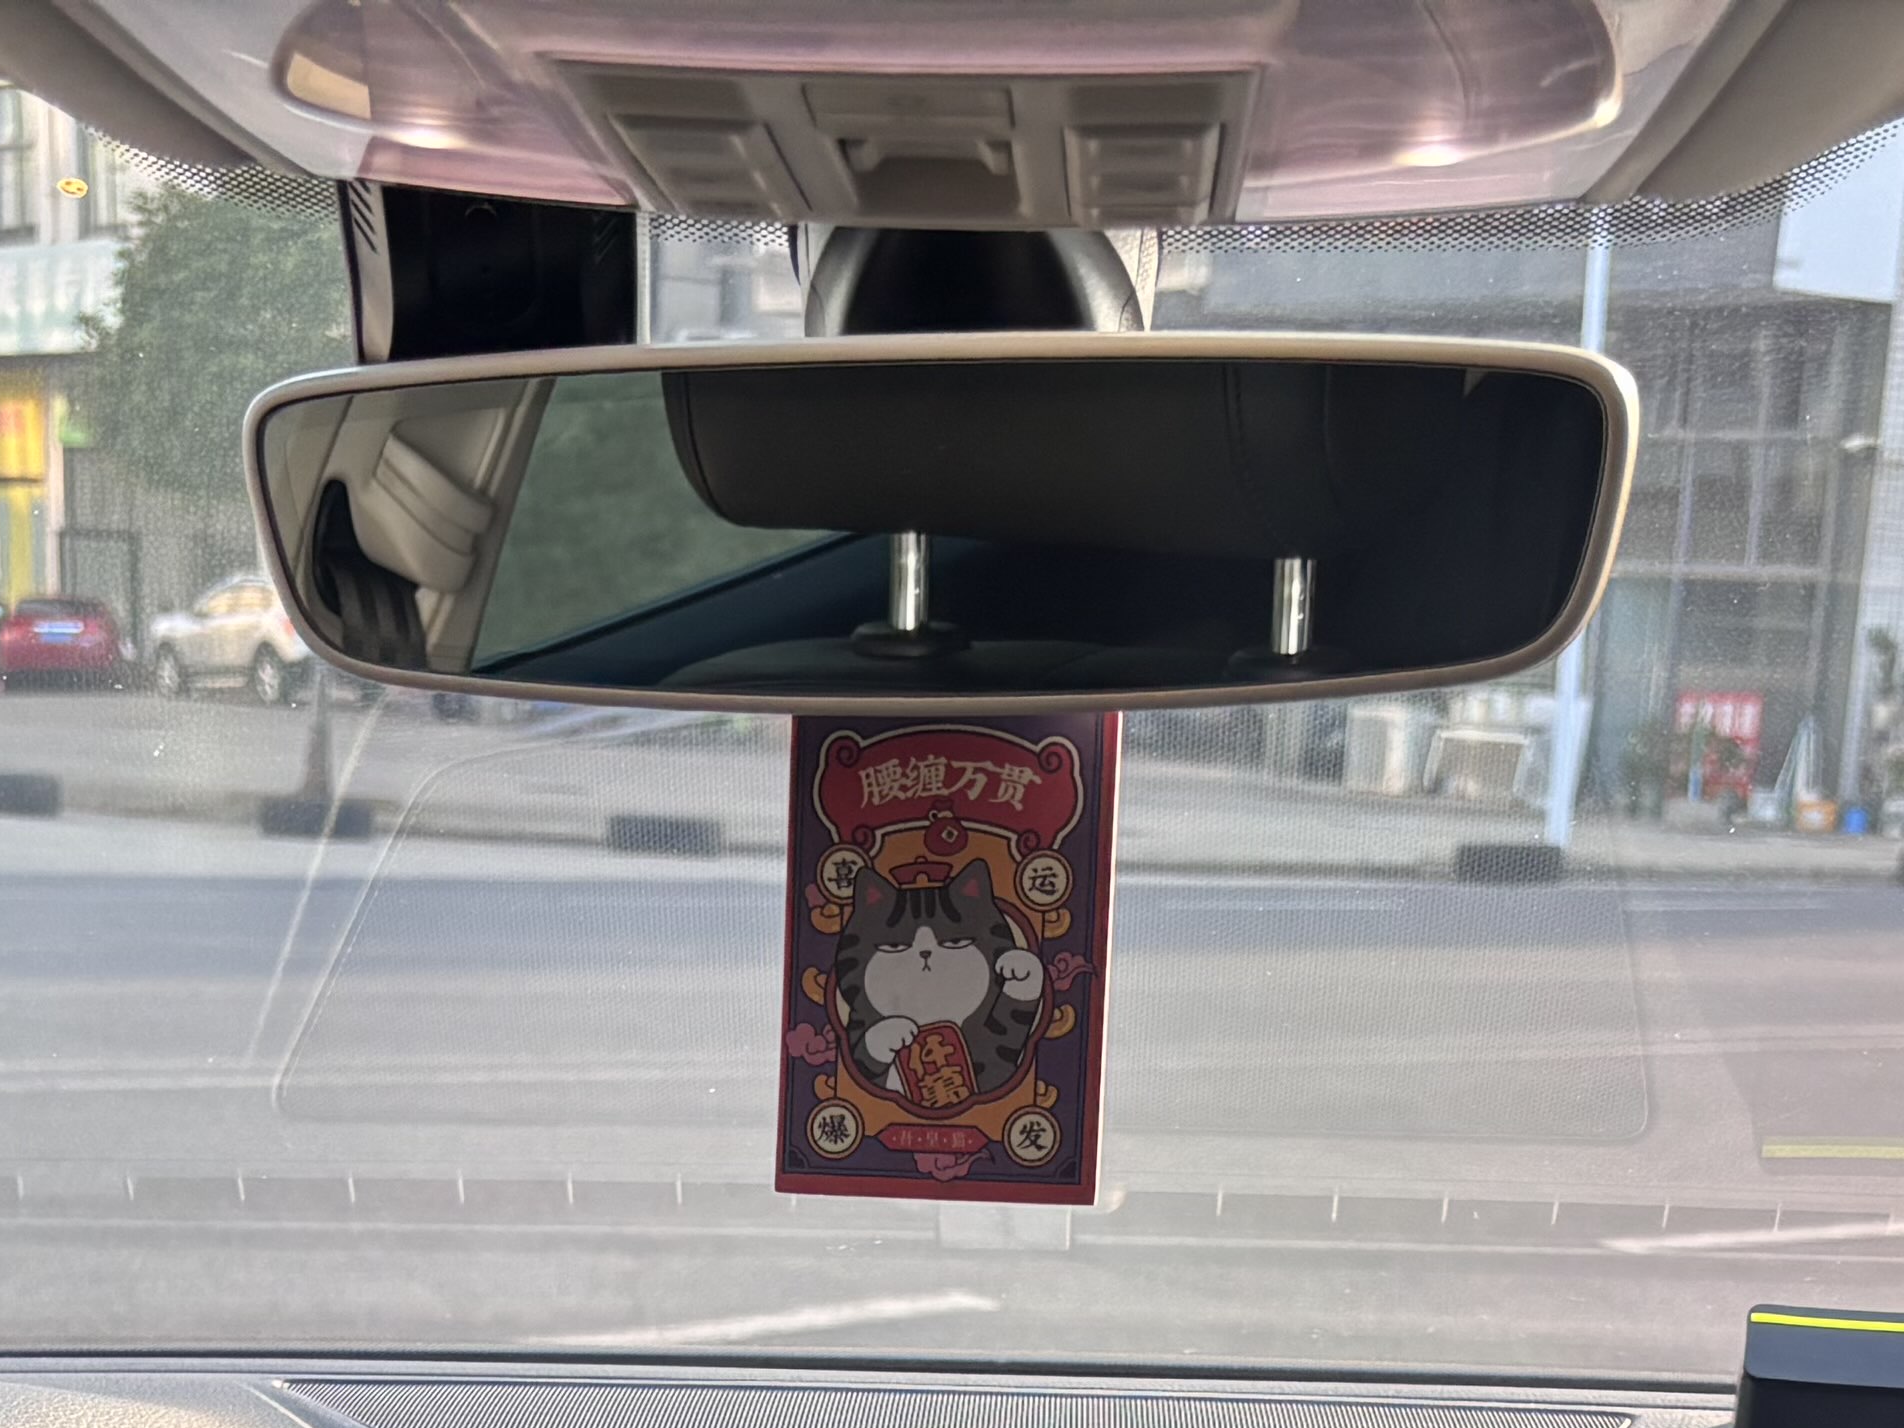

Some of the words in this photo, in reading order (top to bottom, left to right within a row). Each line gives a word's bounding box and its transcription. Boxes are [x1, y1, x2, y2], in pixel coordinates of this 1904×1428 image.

[857, 753, 1043, 812] 腰缠万贯
[827, 857, 858, 891] 喜
[1028, 866, 1060, 895] 运
[816, 1113, 851, 1145] 爆
[1015, 1120, 1049, 1152] 发
